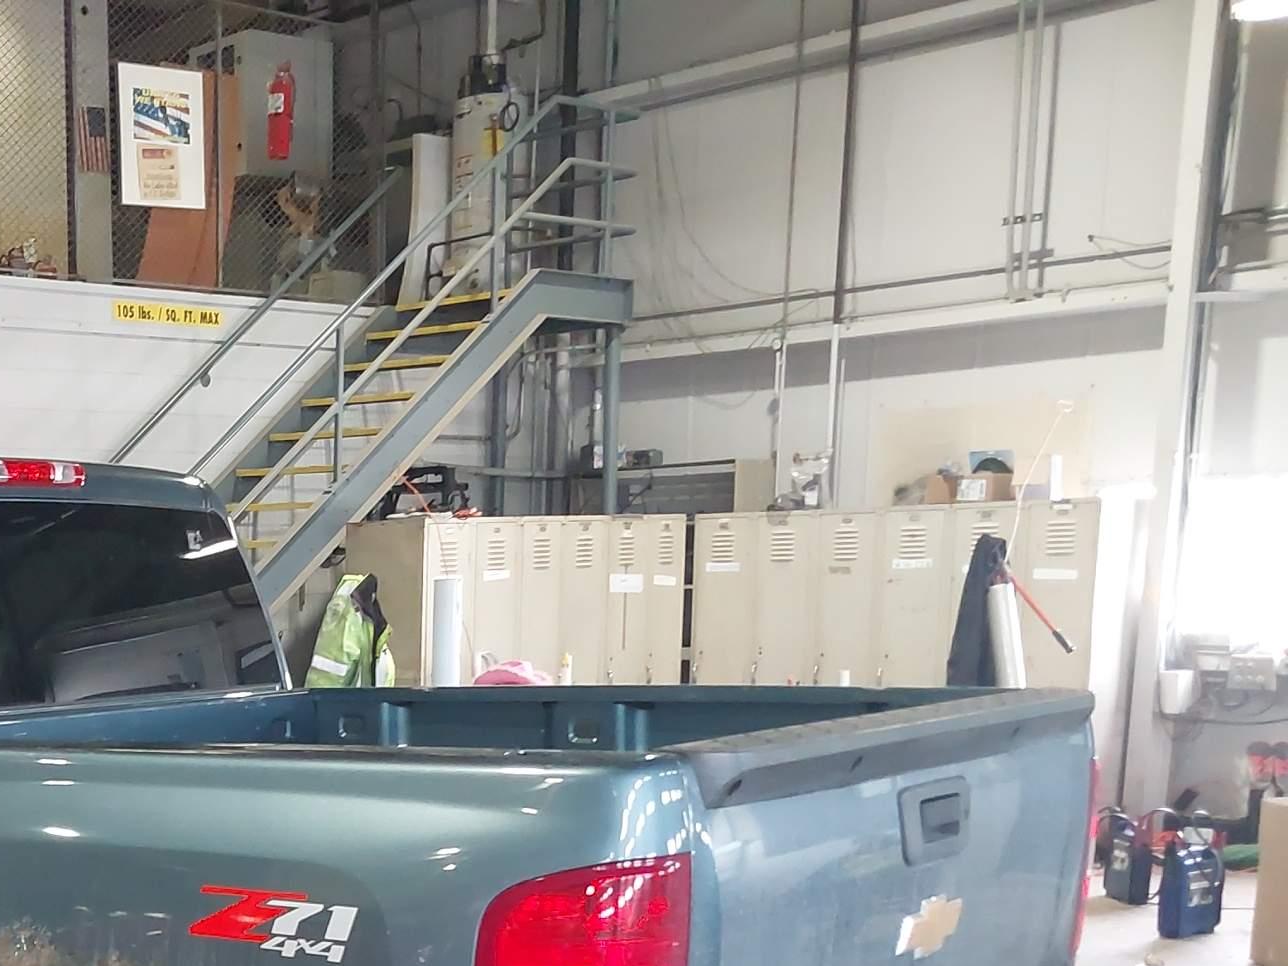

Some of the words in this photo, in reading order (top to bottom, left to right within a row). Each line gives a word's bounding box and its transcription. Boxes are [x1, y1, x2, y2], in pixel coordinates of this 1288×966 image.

[116, 304, 134, 318] 105
[138, 305, 154, 320] lbs.
[165, 308, 180, 322] SQ.
[184, 310, 196, 323] FT.
[199, 311, 220, 325] MAX
[188, 884, 359, 943] Z71
